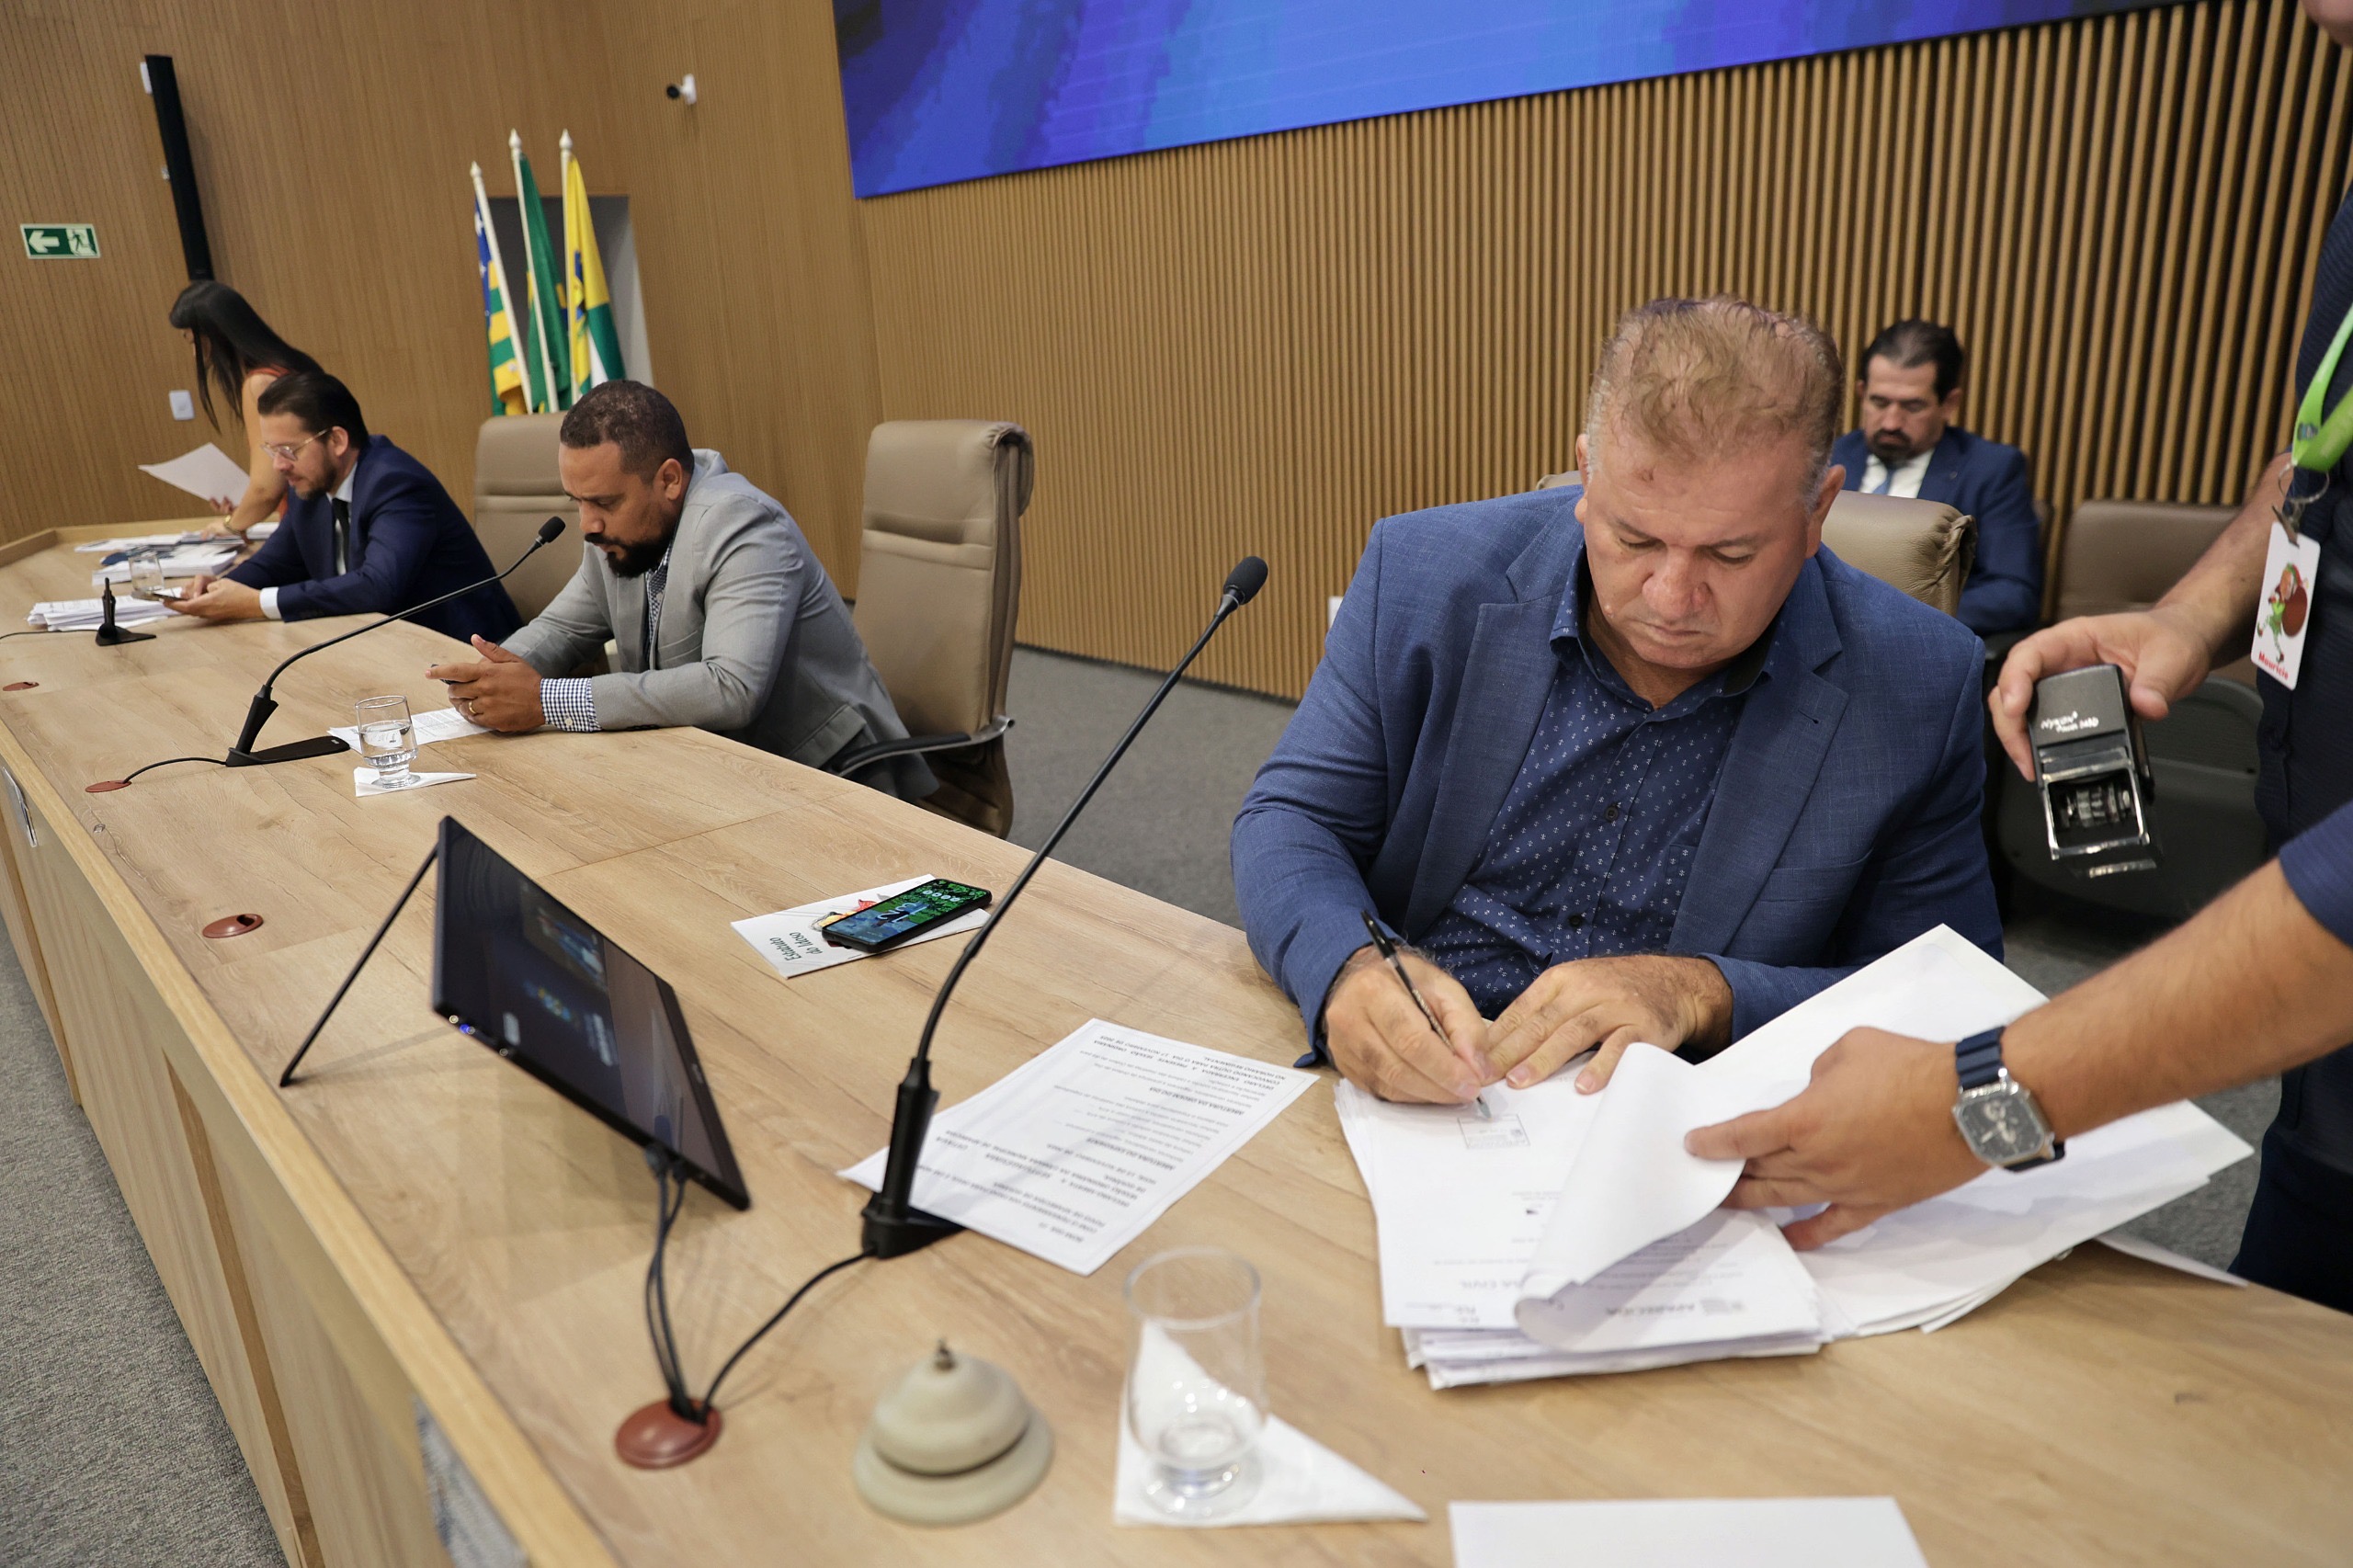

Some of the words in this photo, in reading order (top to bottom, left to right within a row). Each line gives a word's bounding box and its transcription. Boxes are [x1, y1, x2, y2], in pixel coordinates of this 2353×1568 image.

[896, 902, 930, 915] 13
[876, 913, 906, 923] 12
[790, 932, 813, 948] Idoso
[769, 937, 802, 960] Estatuto
